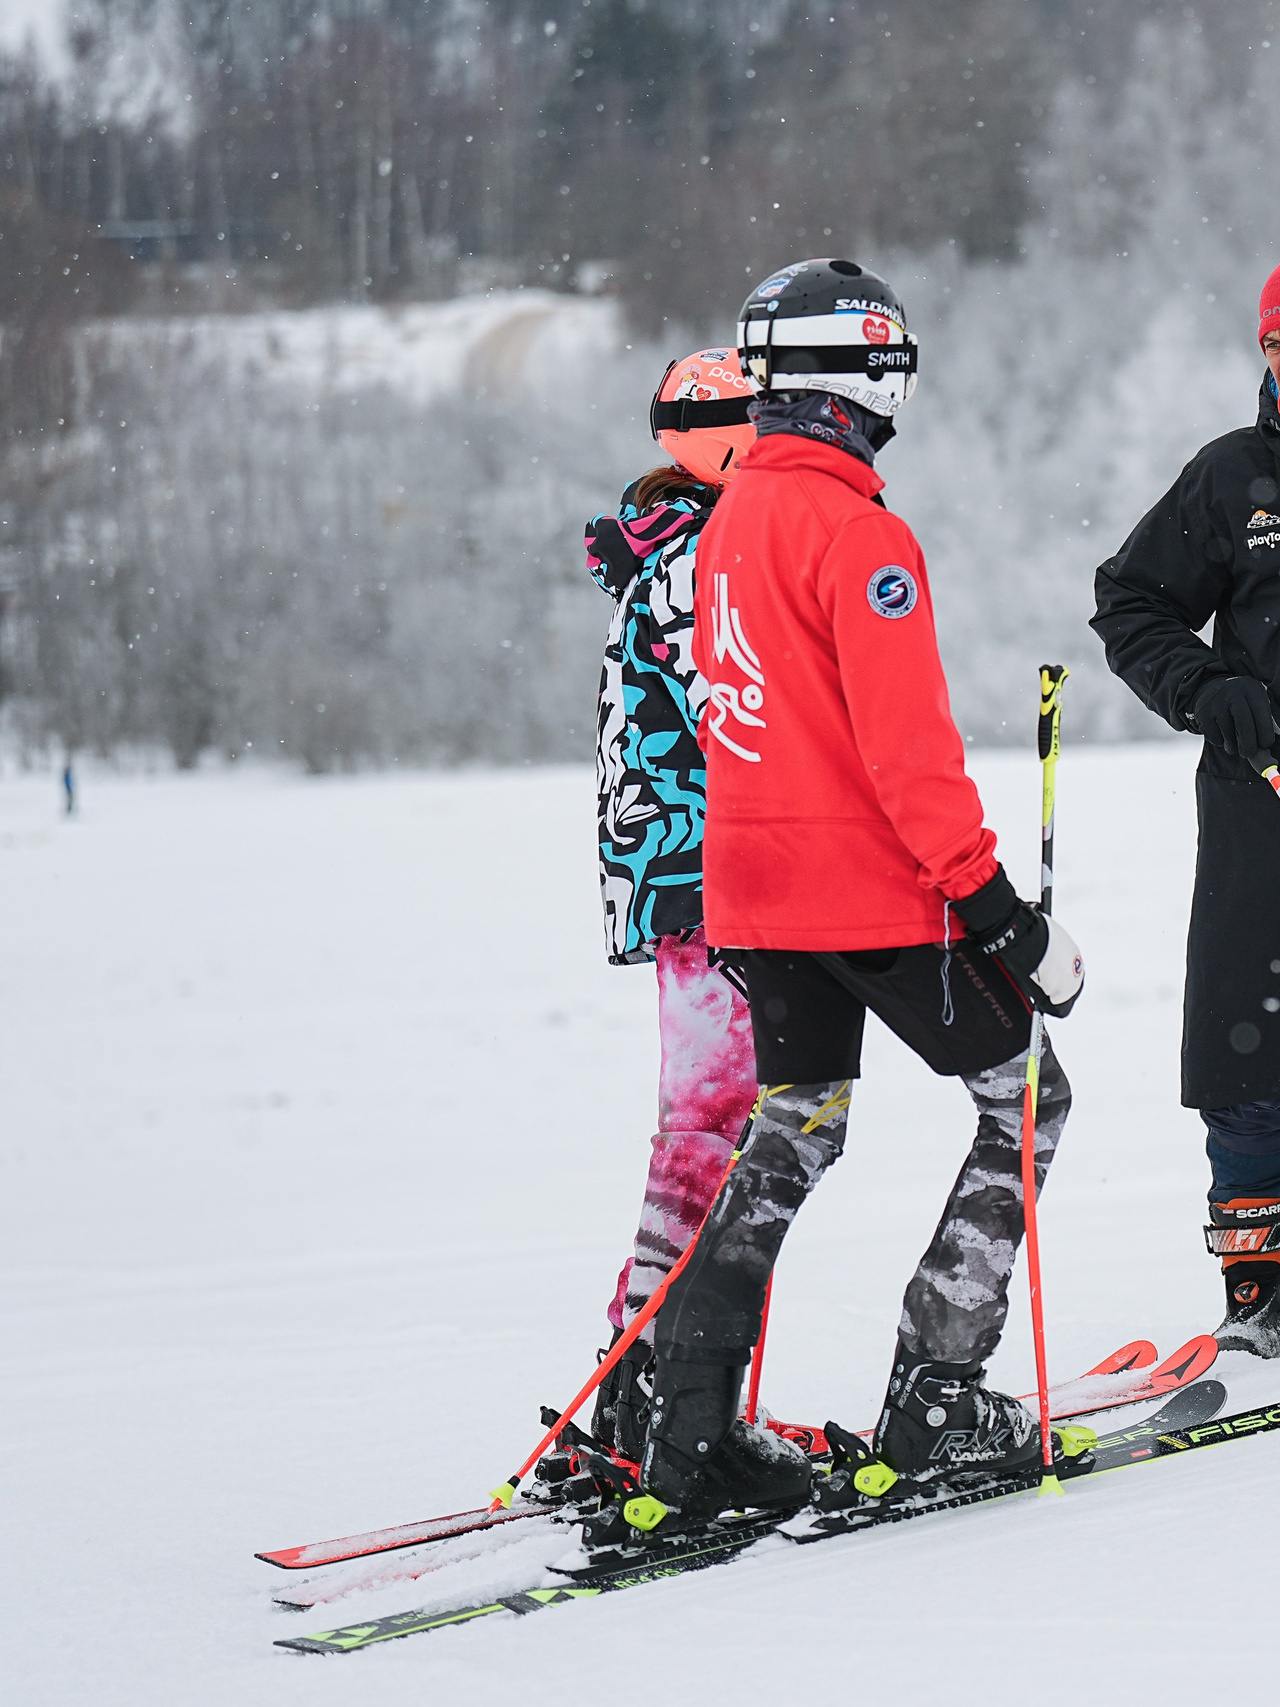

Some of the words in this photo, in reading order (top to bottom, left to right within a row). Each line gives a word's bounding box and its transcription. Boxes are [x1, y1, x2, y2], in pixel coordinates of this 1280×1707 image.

[868, 352, 910, 366] SMITH
[983, 928, 1016, 955] LEKI
[983, 991, 1014, 1029] PRO
[1235, 1229, 1257, 1250] F1
[614, 1575, 653, 1589] RC4
